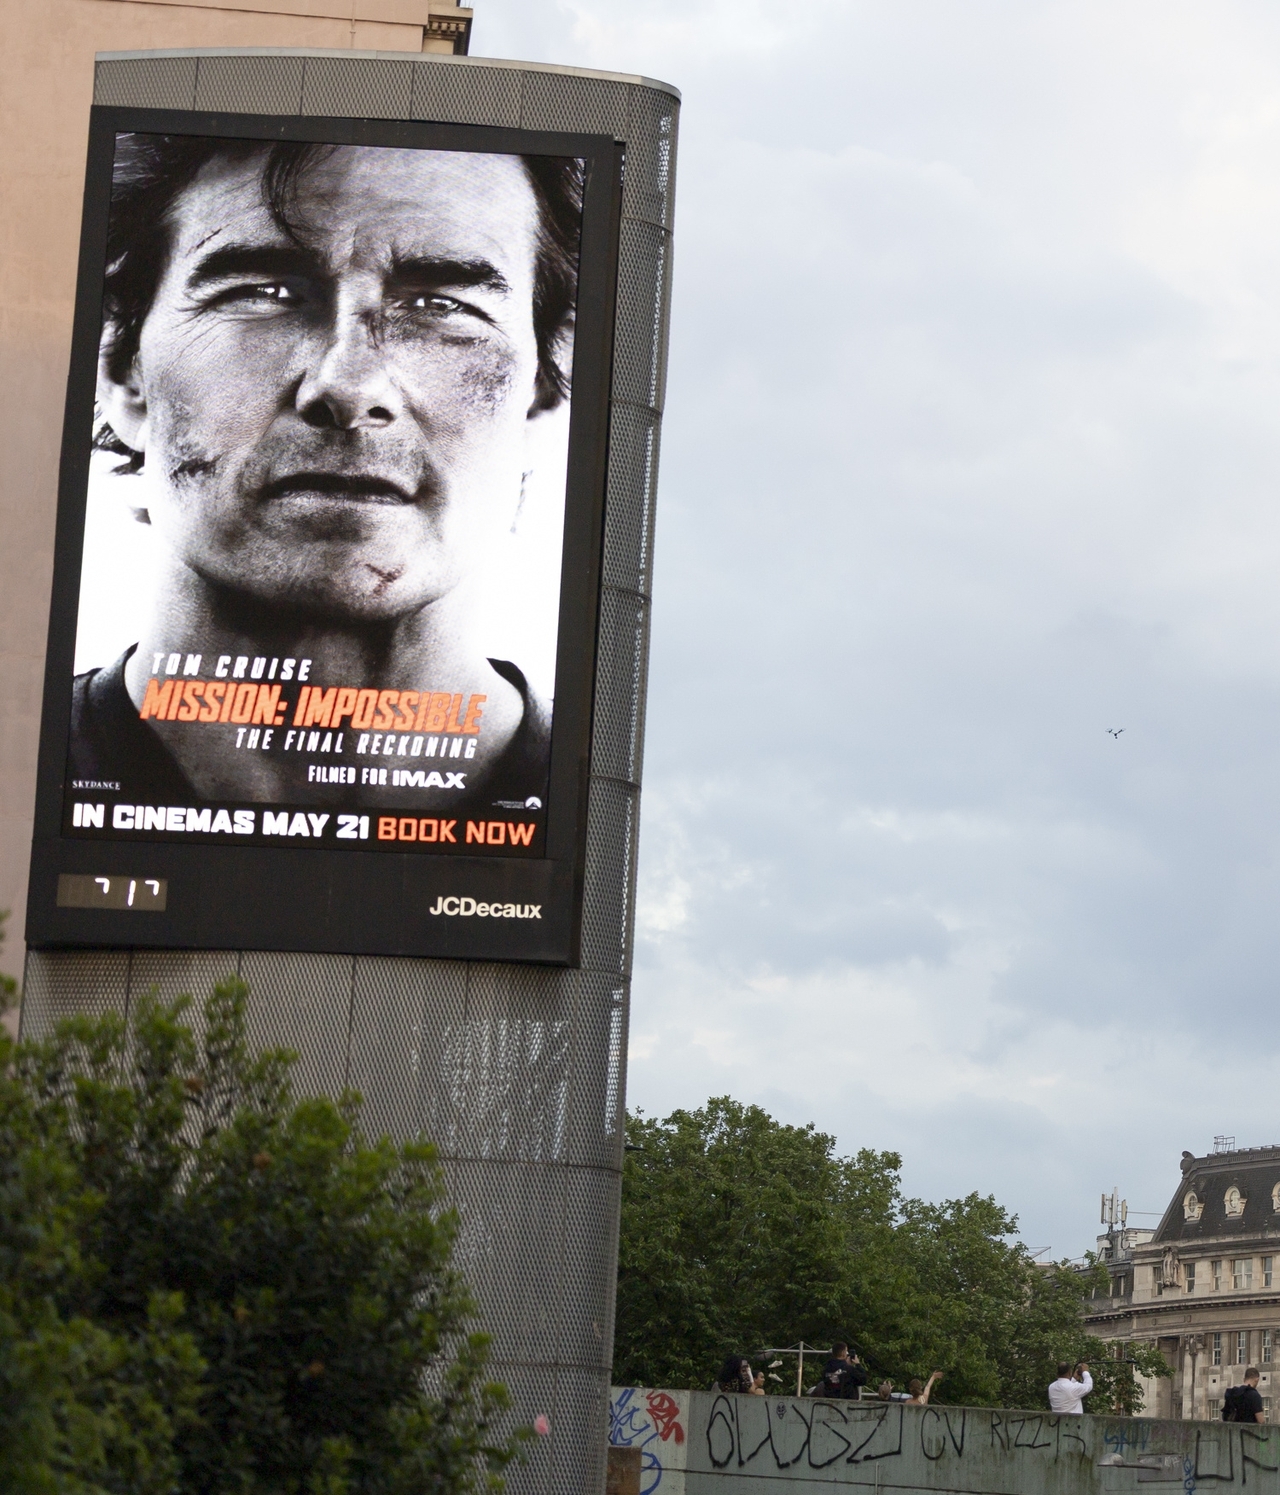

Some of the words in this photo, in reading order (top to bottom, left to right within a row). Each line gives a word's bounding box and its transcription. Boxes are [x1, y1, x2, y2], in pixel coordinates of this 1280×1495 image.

[151, 652, 202, 676] TOM
[215, 655, 312, 682] CRUISE
[139, 679, 288, 726] MISSION:
[292, 685, 487, 735] IMPOSSIBLE
[236, 728, 274, 750] THE
[285, 730, 343, 753] FINAL
[357, 734, 478, 759] RECKONING
[72, 780, 121, 791] SKYDANCE
[308, 765, 356, 784] FILMED
[361, 768, 388, 786] FOR
[392, 770, 466, 789] IMAX
[72, 803, 105, 829] IN
[112, 804, 255, 835] CINEMAS
[262, 811, 330, 837] MAY
[336, 814, 370, 840] 21
[378, 817, 457, 843] BOOK
[466, 820, 536, 846] NOW
[429, 896, 542, 919] JCDecaux
